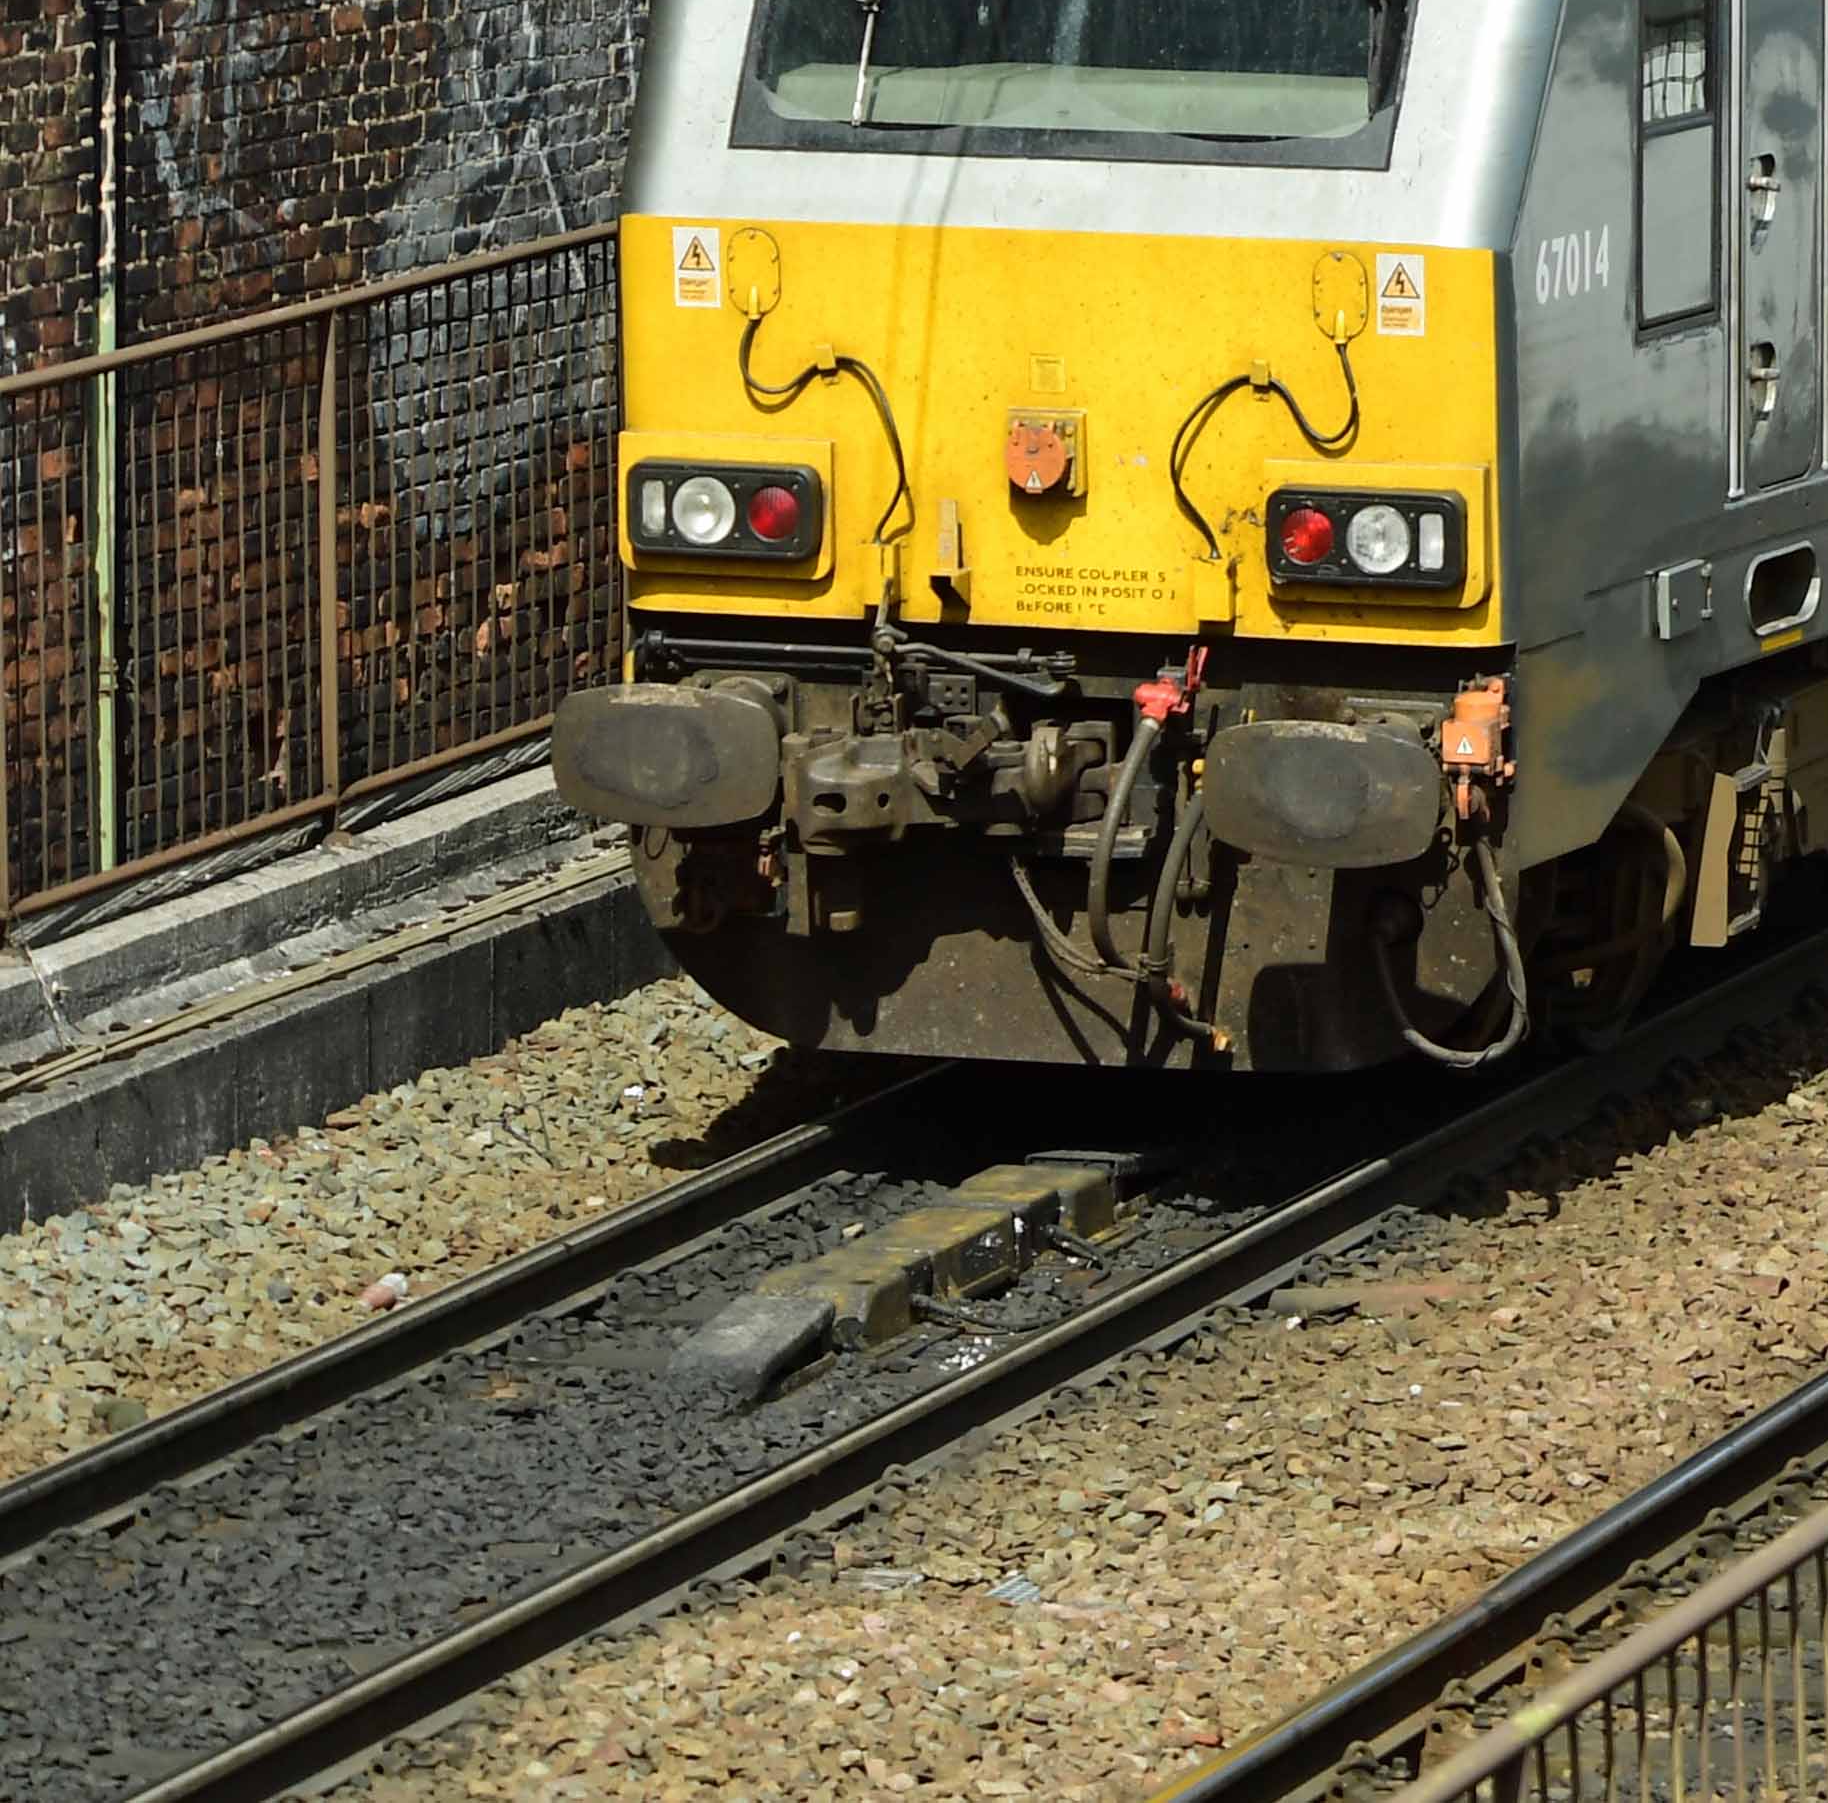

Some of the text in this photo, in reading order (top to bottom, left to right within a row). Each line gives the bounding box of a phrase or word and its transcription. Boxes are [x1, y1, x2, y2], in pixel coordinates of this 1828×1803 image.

[1535, 223, 1610, 305] 67014
[1015, 565, 1074, 580] ENSURE
[1081, 585, 1098, 597] IN
[1015, 599, 1073, 614] BEFORE
